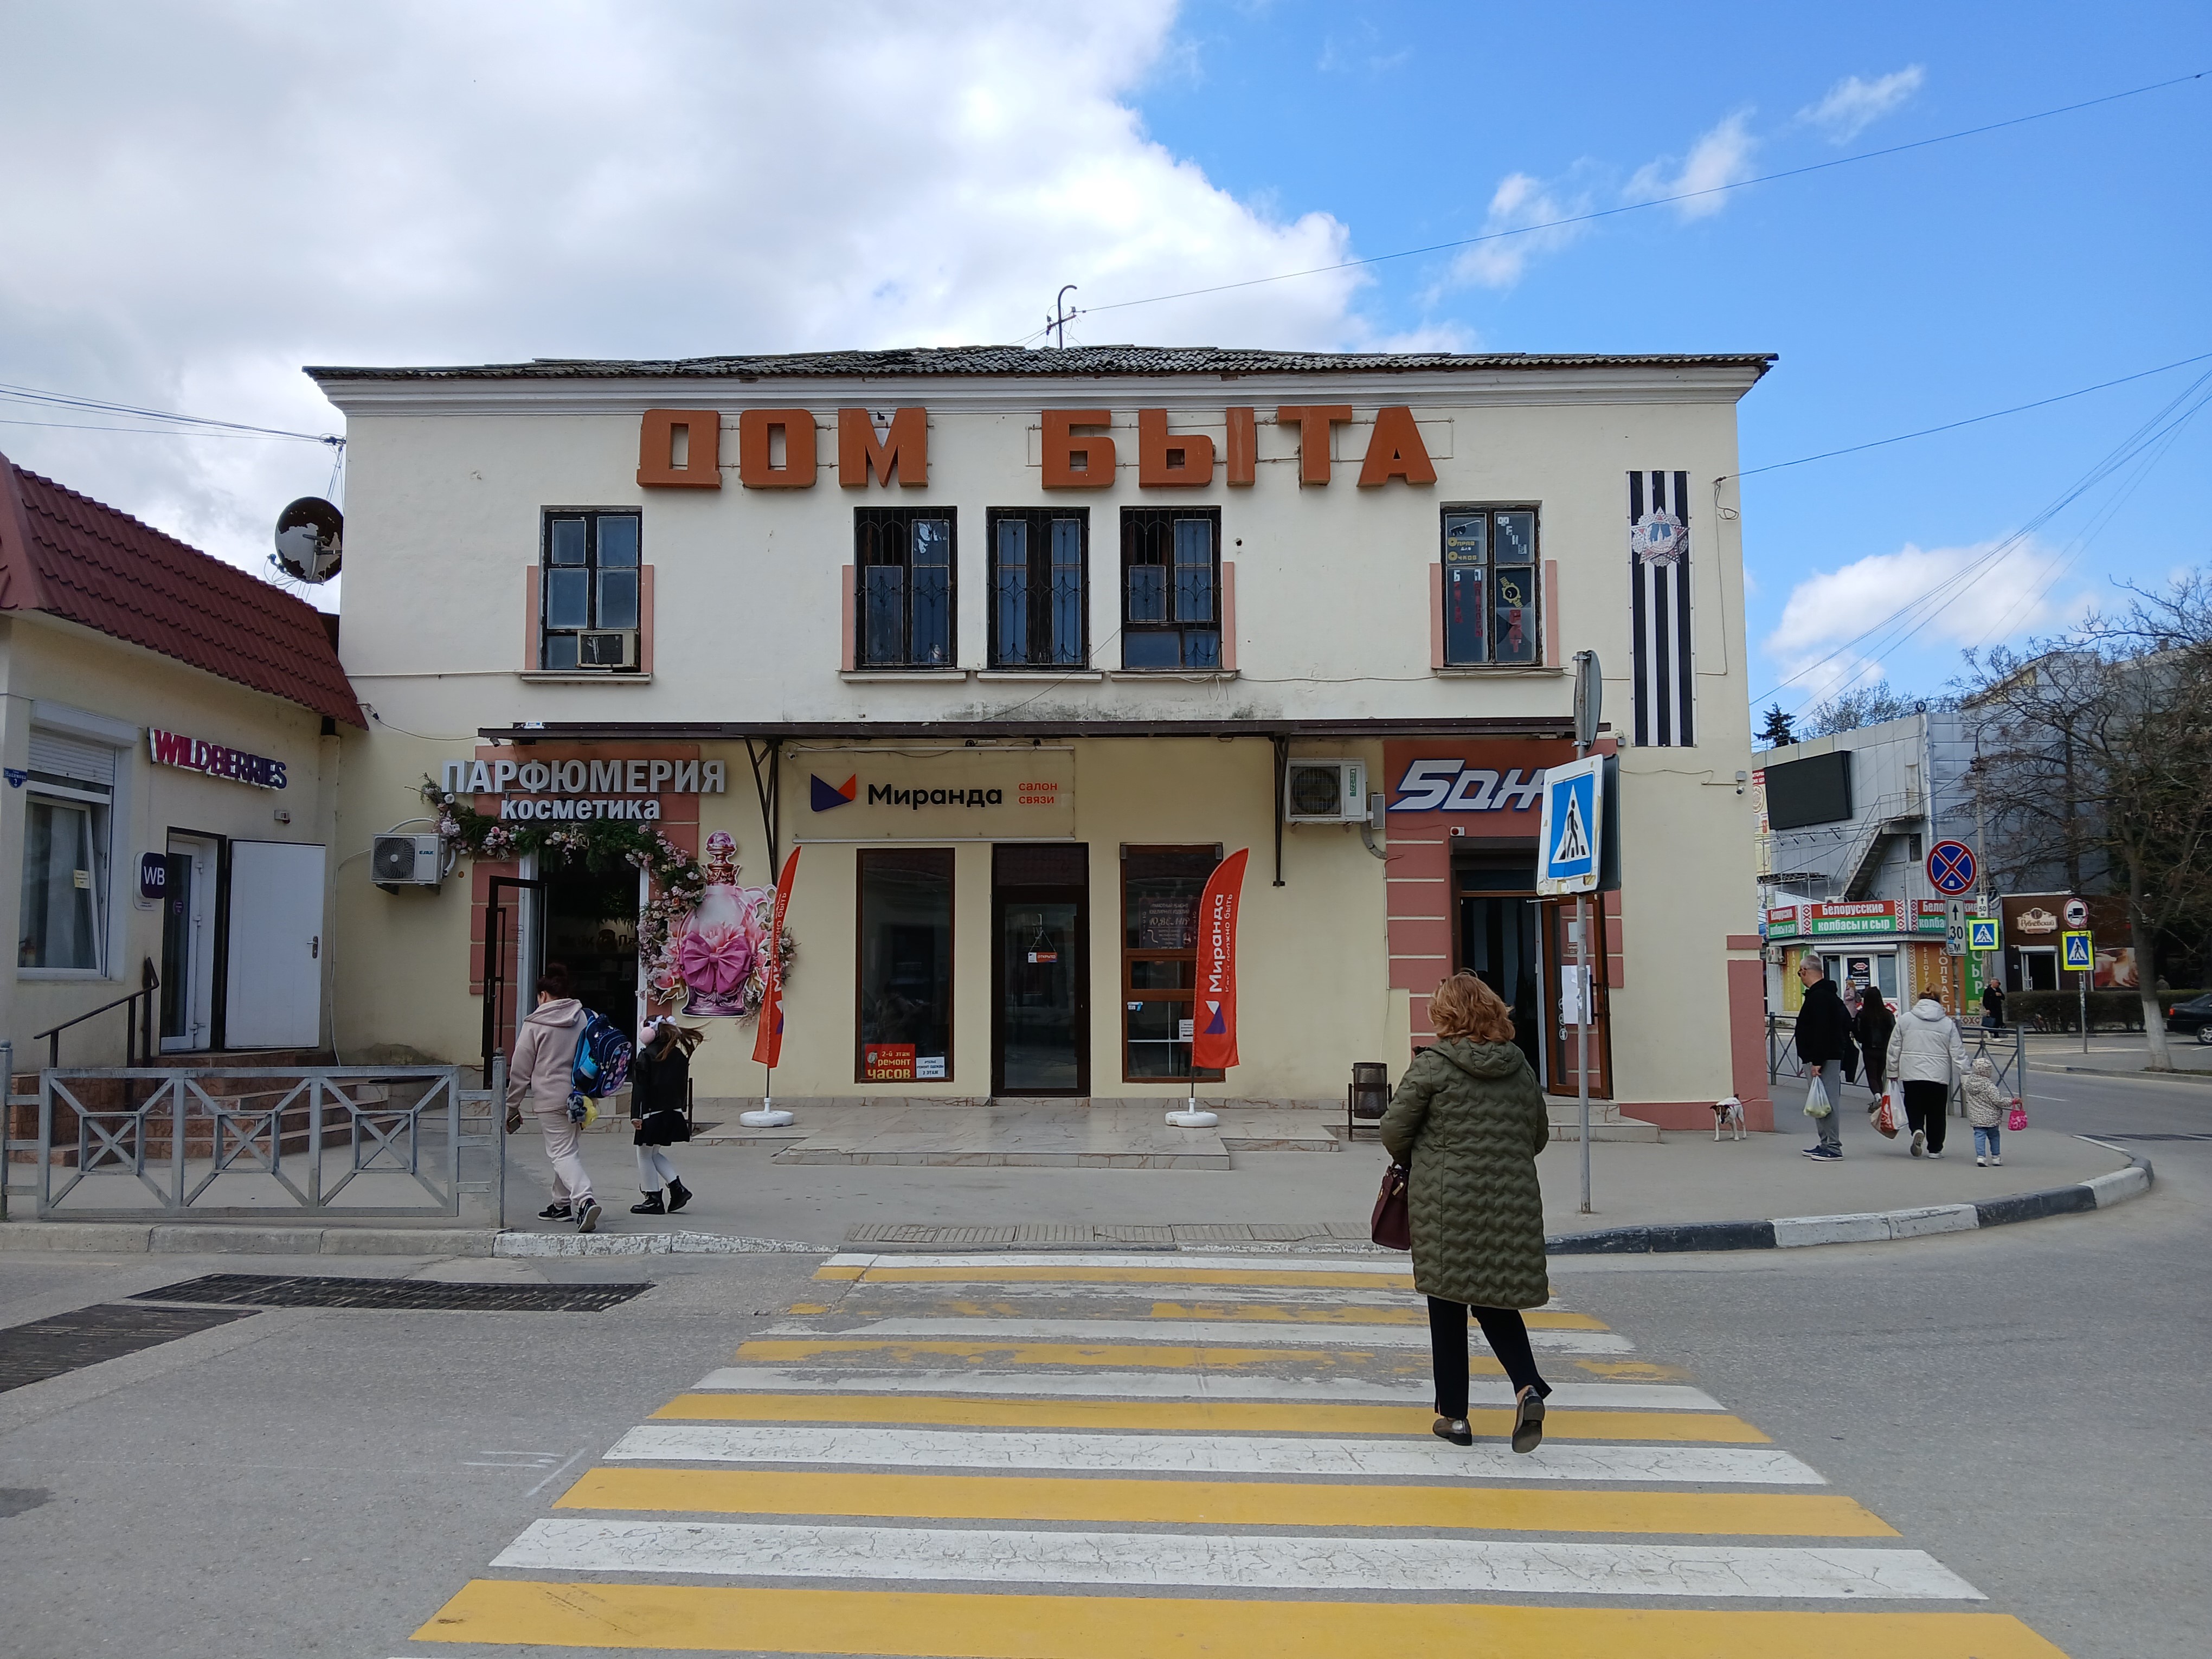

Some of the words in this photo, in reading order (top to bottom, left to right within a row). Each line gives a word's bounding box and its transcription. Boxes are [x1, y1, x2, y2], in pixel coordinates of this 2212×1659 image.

[636, 408, 928, 487] ДОМ
[1041, 405, 1437, 489] БЫТА
[149, 728, 287, 789] WILDBERRIES
[441, 759, 727, 794] ПАРФЮМЕРИЯ
[1018, 782, 1058, 791] салон
[868, 784, 1002, 811] Миранда
[1018, 795, 1055, 804] связи
[500, 800, 661, 820] косметика
[144, 866, 165, 885] WB
[1224, 894, 1233, 919] быть
[1822, 903, 1884, 916] Белорусские
[1818, 919, 1860, 931] колбасы
[1862, 921, 1868, 930] и
[1870, 919, 1890, 930] сыр
[1950, 926, 1963, 940] 30
[1209, 894, 1225, 993] Миранда
[1939, 948, 1951, 1013] КОЛБАСЫ
[878, 1059, 911, 1067] ремонт
[867, 1069, 911, 1079] часов
